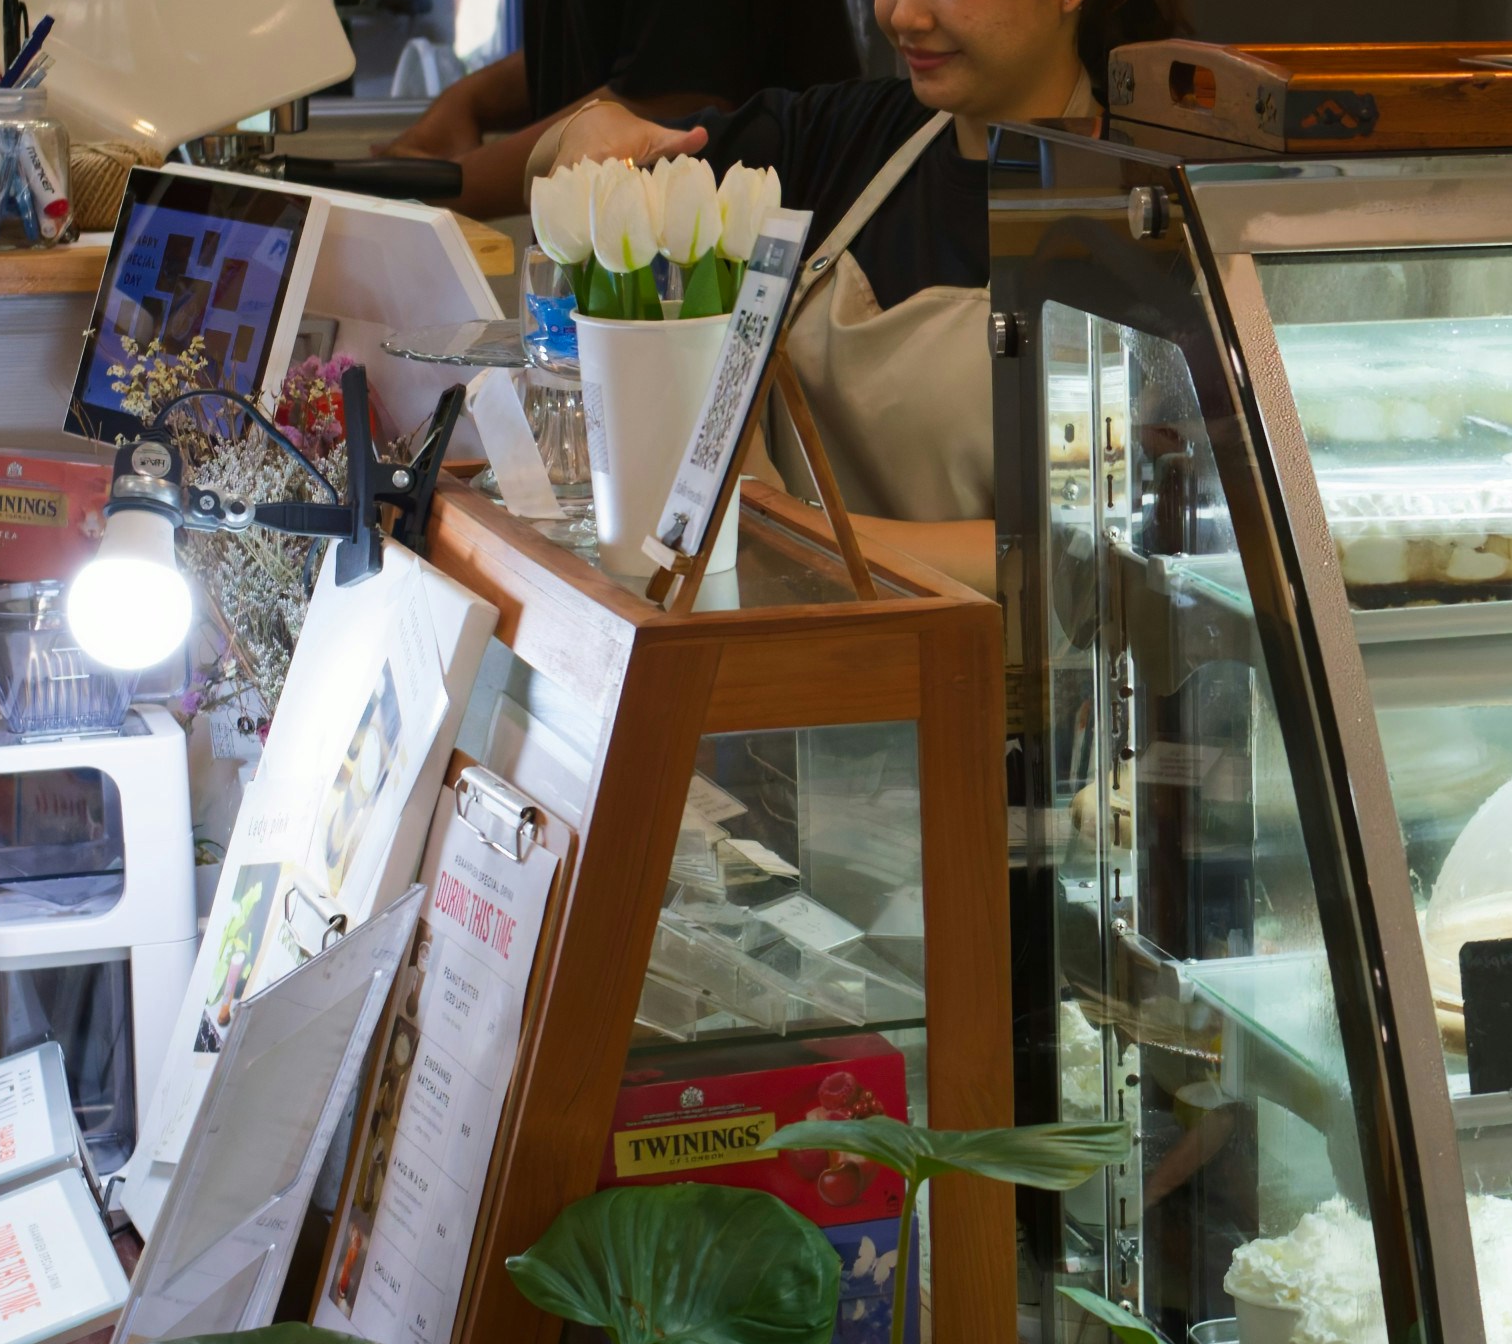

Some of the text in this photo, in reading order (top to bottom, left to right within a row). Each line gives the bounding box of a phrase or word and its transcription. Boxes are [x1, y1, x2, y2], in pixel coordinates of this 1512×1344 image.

[26, 146, 55, 195] marker
[435, 870, 517, 960] DURING THIS TIME
[444, 966, 479, 1001] PEANUT BUTTER
[444, 990, 470, 1017] ICED LATTE
[417, 1074, 437, 1095] MATCHA
[629, 1125, 760, 1161] TWININGS
[669, 1153, 724, 1166] OF LONDON
[39, 1250, 54, 1274] SPECIAL
